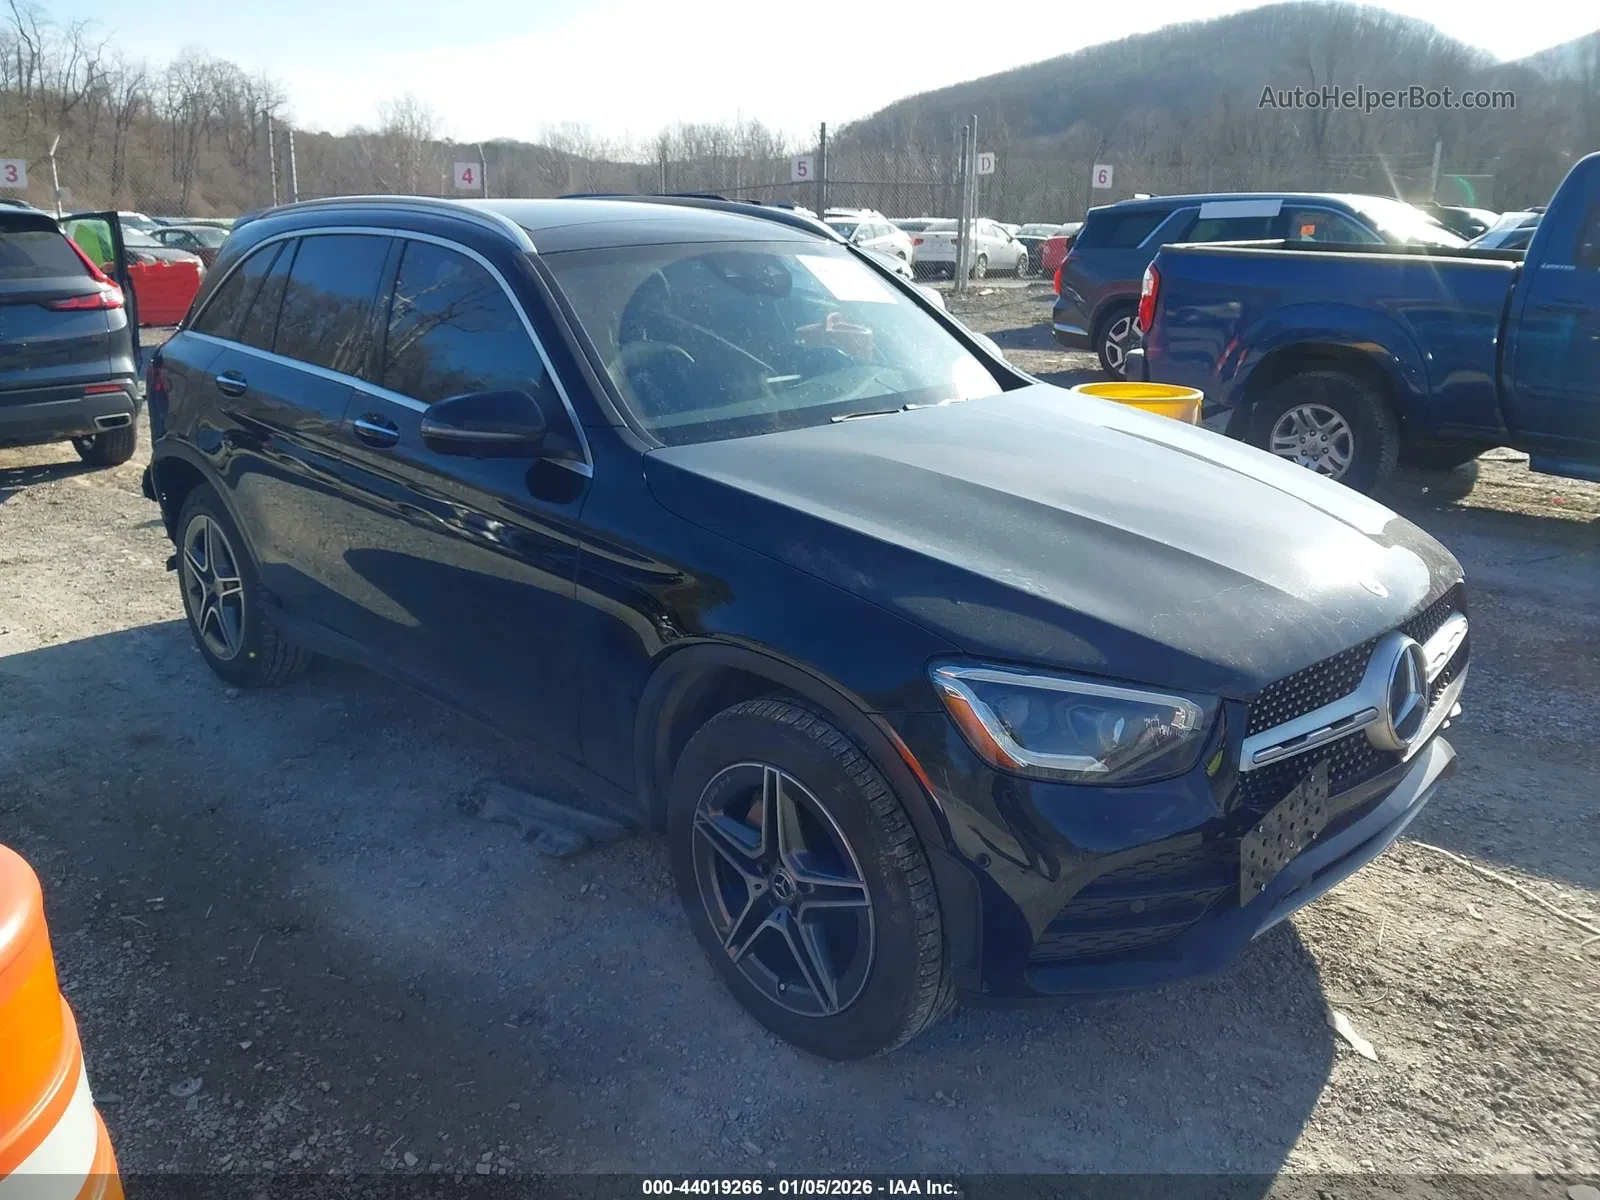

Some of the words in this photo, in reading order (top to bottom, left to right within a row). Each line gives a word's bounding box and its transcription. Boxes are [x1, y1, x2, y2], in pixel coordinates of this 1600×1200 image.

[797, 160, 807, 178] 5
[981, 157, 991, 171] D
[4, 164, 19, 183] 3
[462, 167, 474, 185] 4
[1098, 169, 1108, 184] 6
